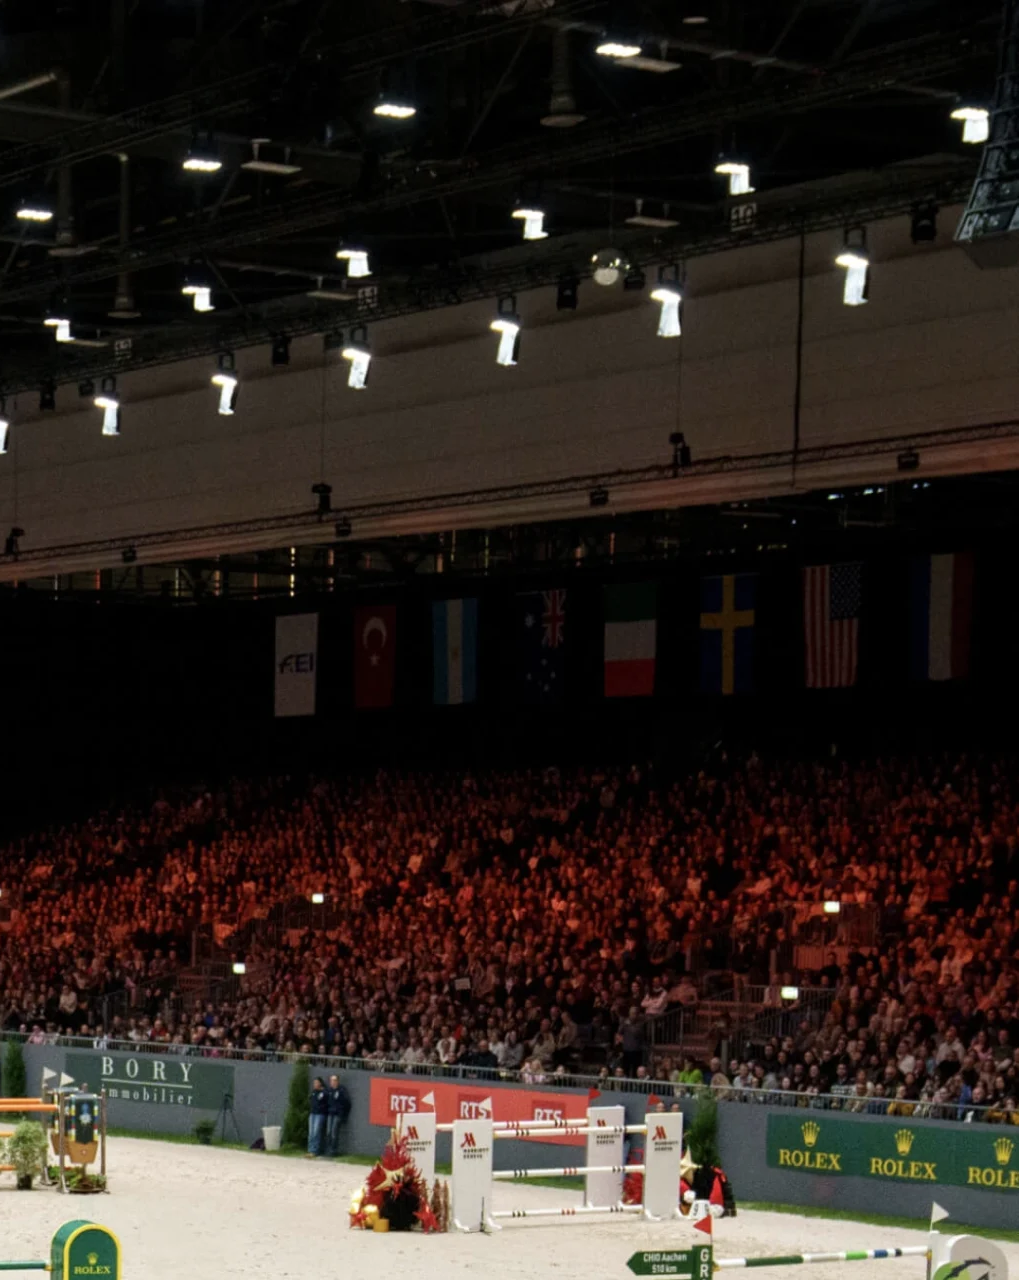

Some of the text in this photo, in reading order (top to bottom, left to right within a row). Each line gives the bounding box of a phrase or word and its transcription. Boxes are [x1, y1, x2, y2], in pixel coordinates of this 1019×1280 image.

[101, 1056, 193, 1083] BORY
[101, 1084, 193, 1105] mmobilier
[390, 1094, 417, 1112] RTS
[534, 1107, 563, 1121] RTS
[779, 1148, 842, 1171] ROLEX
[870, 1156, 938, 1180] ROLEX
[967, 1166, 1019, 1188] ROLE
[661, 1253, 687, 1262] Aachen
[74, 1265, 111, 1275] ROLEX
[665, 1264, 677, 1273] km
